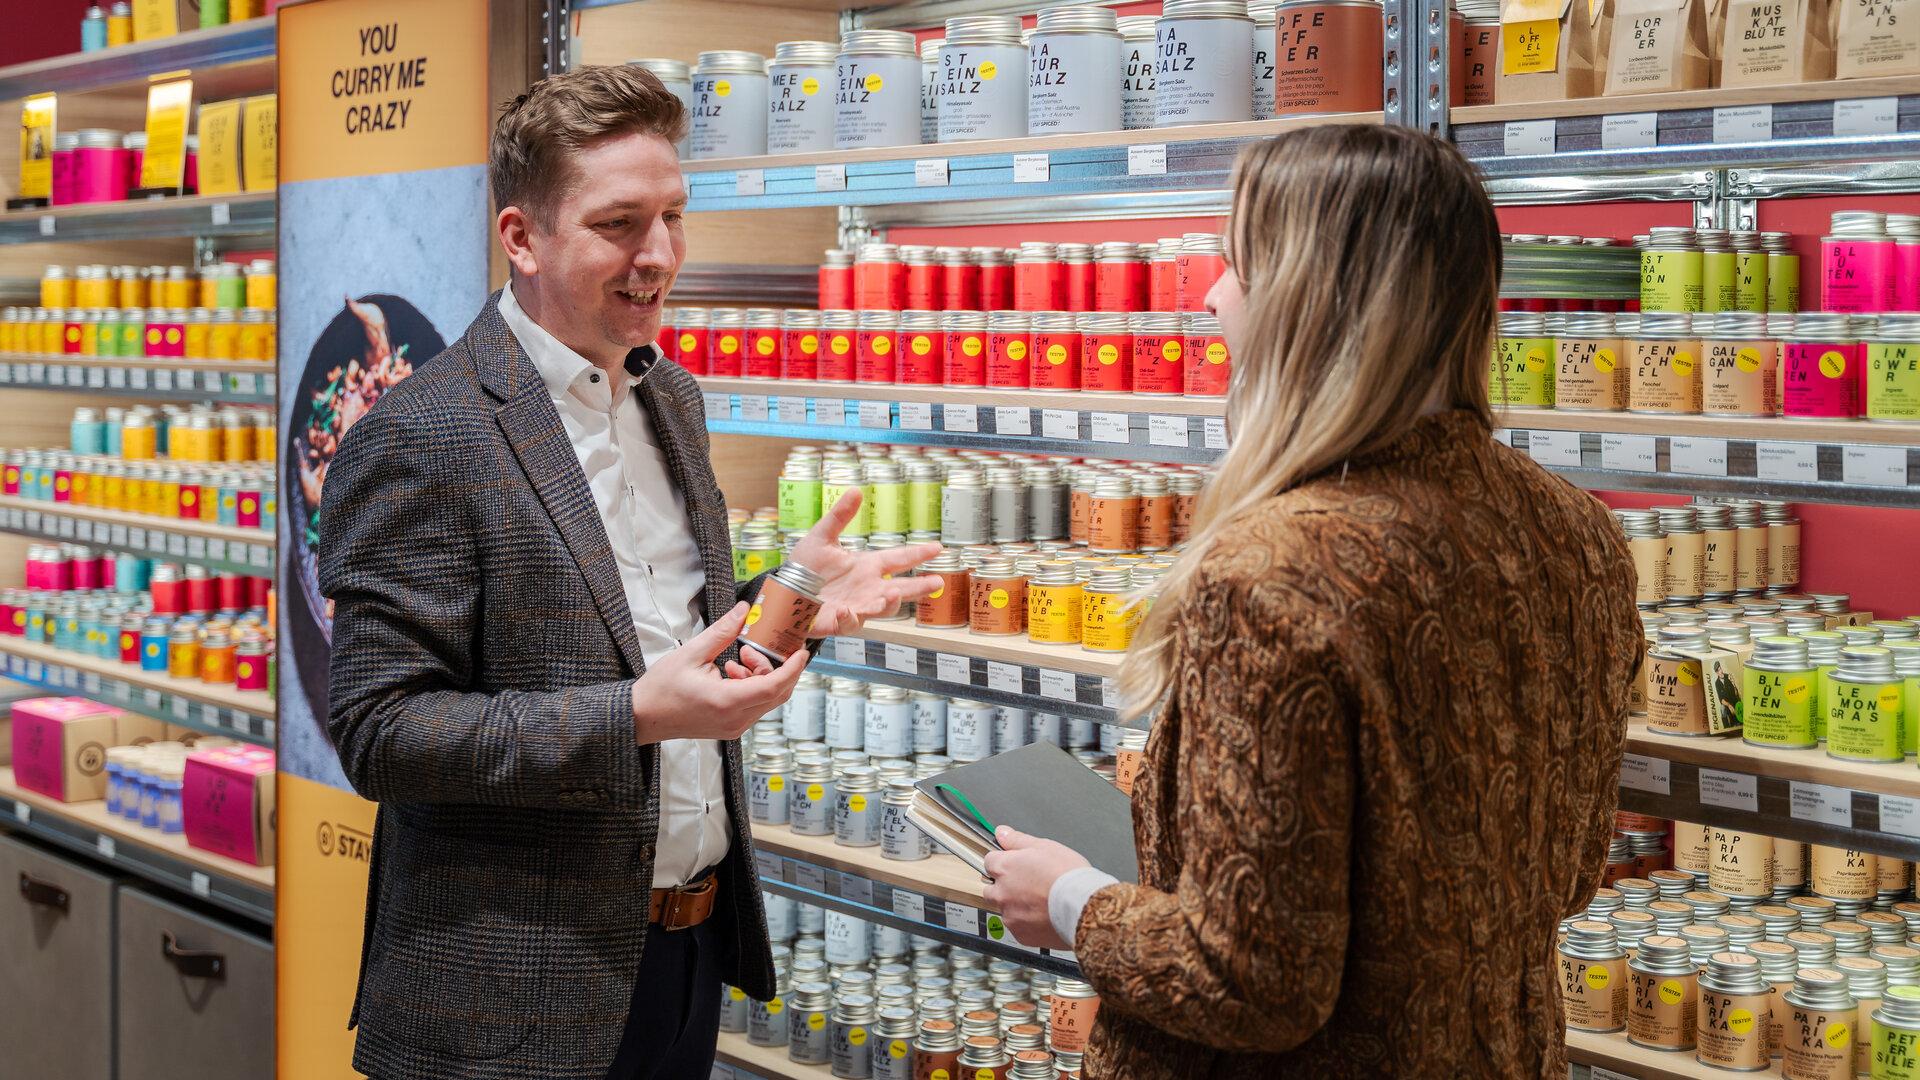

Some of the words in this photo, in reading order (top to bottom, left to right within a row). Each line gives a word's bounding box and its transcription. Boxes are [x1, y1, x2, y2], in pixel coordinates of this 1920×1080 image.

[1751, 5, 1782, 17] MUS
[1279, 12, 1325, 30] PFE
[1635, 17, 1661, 28] LOR
[1752, 16, 1781, 28] KAT
[1281, 30, 1307, 46] FF
[1634, 29, 1656, 39] BE
[1744, 26, 1786, 40] BLÜTE
[359, 23, 398, 56] YOU
[1638, 39, 1655, 49] ER
[1158, 42, 1188, 58] TUR
[1287, 45, 1319, 62] ER
[1031, 58, 1060, 72] TUR
[1156, 57, 1195, 74] SALZ
[332, 63, 395, 98] CURRY
[397, 57, 427, 90] ME
[947, 66, 976, 81] EIN
[1029, 72, 1067, 87] SALZ
[772, 74, 798, 86] MEE
[840, 77, 865, 90] EIN
[782, 87, 790, 98] R
[941, 81, 981, 95] SALZ
[701, 93, 708, 104] R
[835, 91, 870, 104] SALZ
[771, 100, 805, 112] SALZ
[346, 100, 411, 134] CRAZY
[1833, 246, 1856, 257] BL
[1828, 269, 1854, 279] TEN
[1085, 337, 1098, 346] CH
[1561, 343, 1597, 353] FEN
[1638, 345, 1676, 355] FEN
[1712, 346, 1738, 356] GAL
[1884, 348, 1907, 358] IN
[1528, 356, 1545, 364] TESTER
[1566, 354, 1590, 363] CH
[1598, 353, 1614, 367] TESTER
[1643, 356, 1669, 366] CH
[1674, 359, 1692, 368] TESTER
[1709, 357, 1735, 367] GAN
[1739, 354, 1759, 366] TESTER
[1826, 356, 1841, 373] TESTER
[1562, 364, 1580, 374] EL
[1873, 360, 1917, 370] GWE
[1638, 367, 1658, 377] EL
[1886, 371, 1895, 382] R
[1088, 614, 1104, 622] ER
[1654, 663, 1661, 673] K
[1681, 666, 1699, 680] TESTER
[1758, 675, 1781, 687] BL
[1659, 686, 1675, 697] EL
[1763, 685, 1772, 697] Ü
[1787, 685, 1806, 696] TESTER
[1837, 686, 1860, 697] LE
[1752, 696, 1781, 708] TEN
[1840, 697, 1877, 710] MON
[1831, 708, 1878, 722] GRAS
[1715, 832, 1741, 844] PAP
[1720, 843, 1734, 854] RI
[1721, 854, 1739, 864] KA
[1847, 858, 1865, 867] KA
[1561, 960, 1586, 973] PAP
[1566, 972, 1579, 983] RI
[1588, 973, 1608, 981] TESTER
[1631, 974, 1656, 988] PAP
[1567, 983, 1584, 994] KA
[1635, 986, 1648, 998] RI
[1662, 987, 1681, 997] TESTER
[1636, 998, 1653, 1009] KA
[1703, 993, 1731, 1007] PAP
[1708, 1006, 1723, 1019] RI
[1057, 1017, 1075, 1027] ER
[1709, 1018, 1729, 1031] KA
[1731, 1017, 1752, 1025] TESTER
[1794, 1012, 1826, 1027] PAP
[1801, 1025, 1818, 1037] RI
[1829, 1028, 1847, 1041] TESTER
[1802, 1036, 1823, 1049] KA
[1887, 1031, 1916, 1045] PET
[1889, 1044, 1907, 1056] ER
[1876, 1052, 1915, 1069] SILIE
